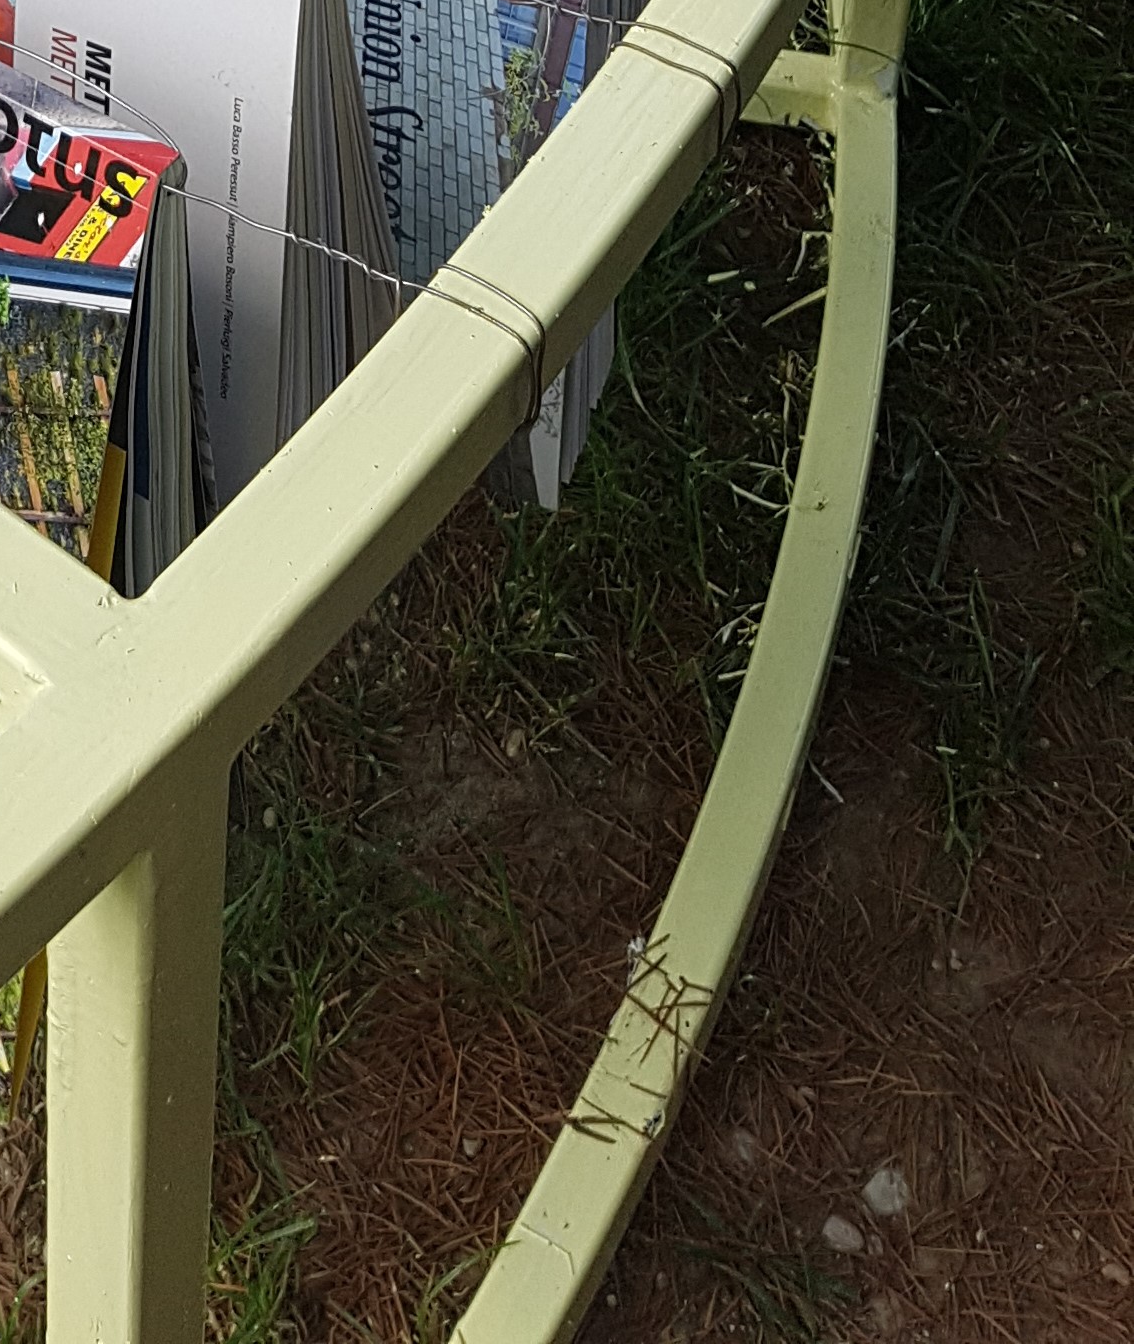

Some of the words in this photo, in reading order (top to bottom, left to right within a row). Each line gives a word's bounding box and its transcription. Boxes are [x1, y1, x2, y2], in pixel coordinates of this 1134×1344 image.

[49, 27, 76, 101] MET
[83, 40, 111, 117] MET
[232, 96, 243, 123] Luca
[229, 124, 242, 156] Basso
[227, 157, 241, 202] Peressut
[224, 210, 239, 265] iampiero
